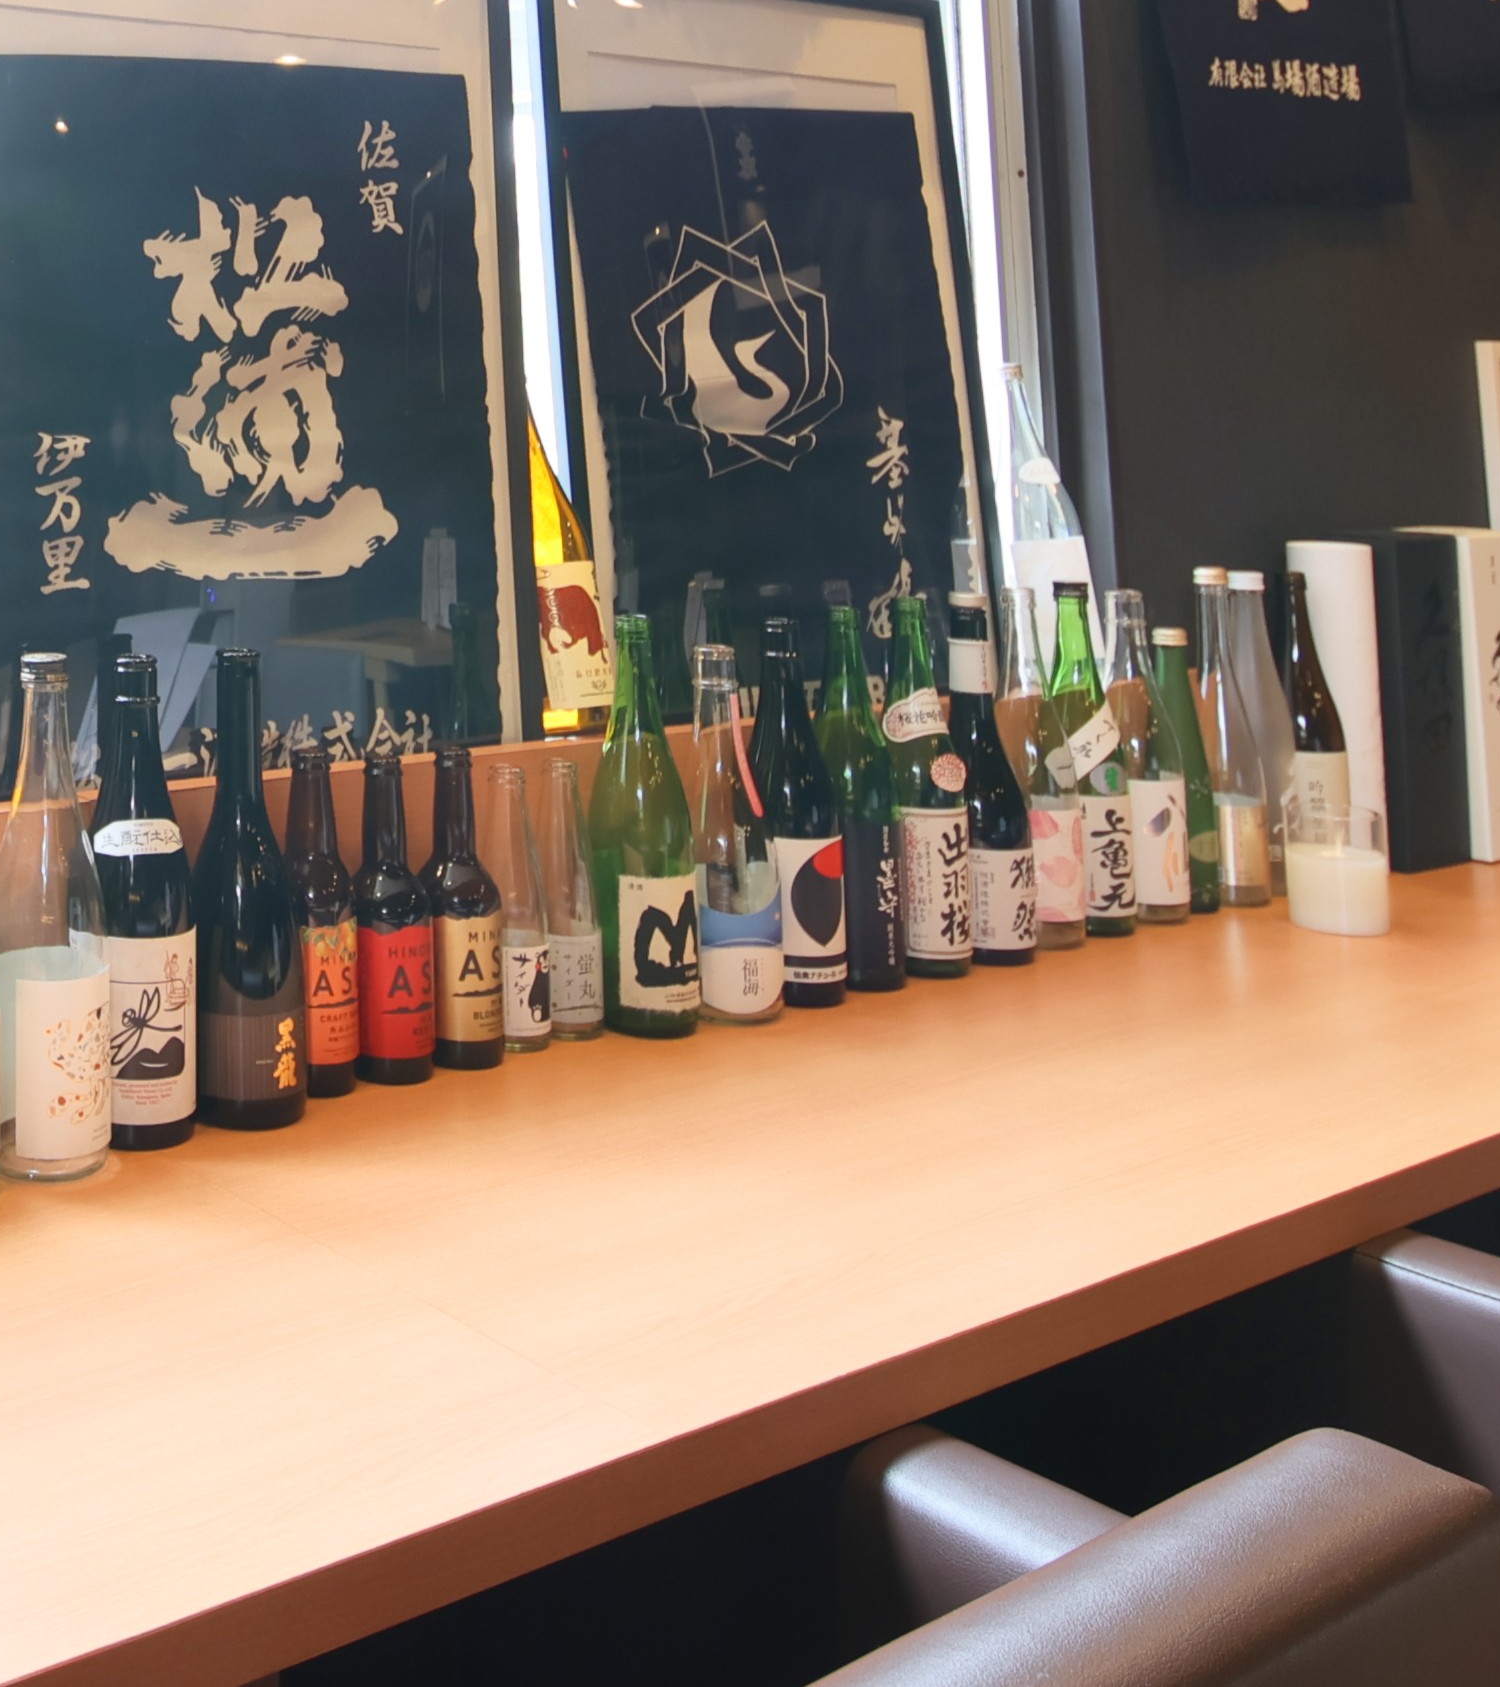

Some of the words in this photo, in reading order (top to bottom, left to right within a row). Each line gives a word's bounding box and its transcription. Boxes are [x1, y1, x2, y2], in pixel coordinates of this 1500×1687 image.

[356, 119, 404, 236] 佐賀
[32, 430, 92, 597] 伊万里
[272, 1017, 297, 1091] 黒龍
